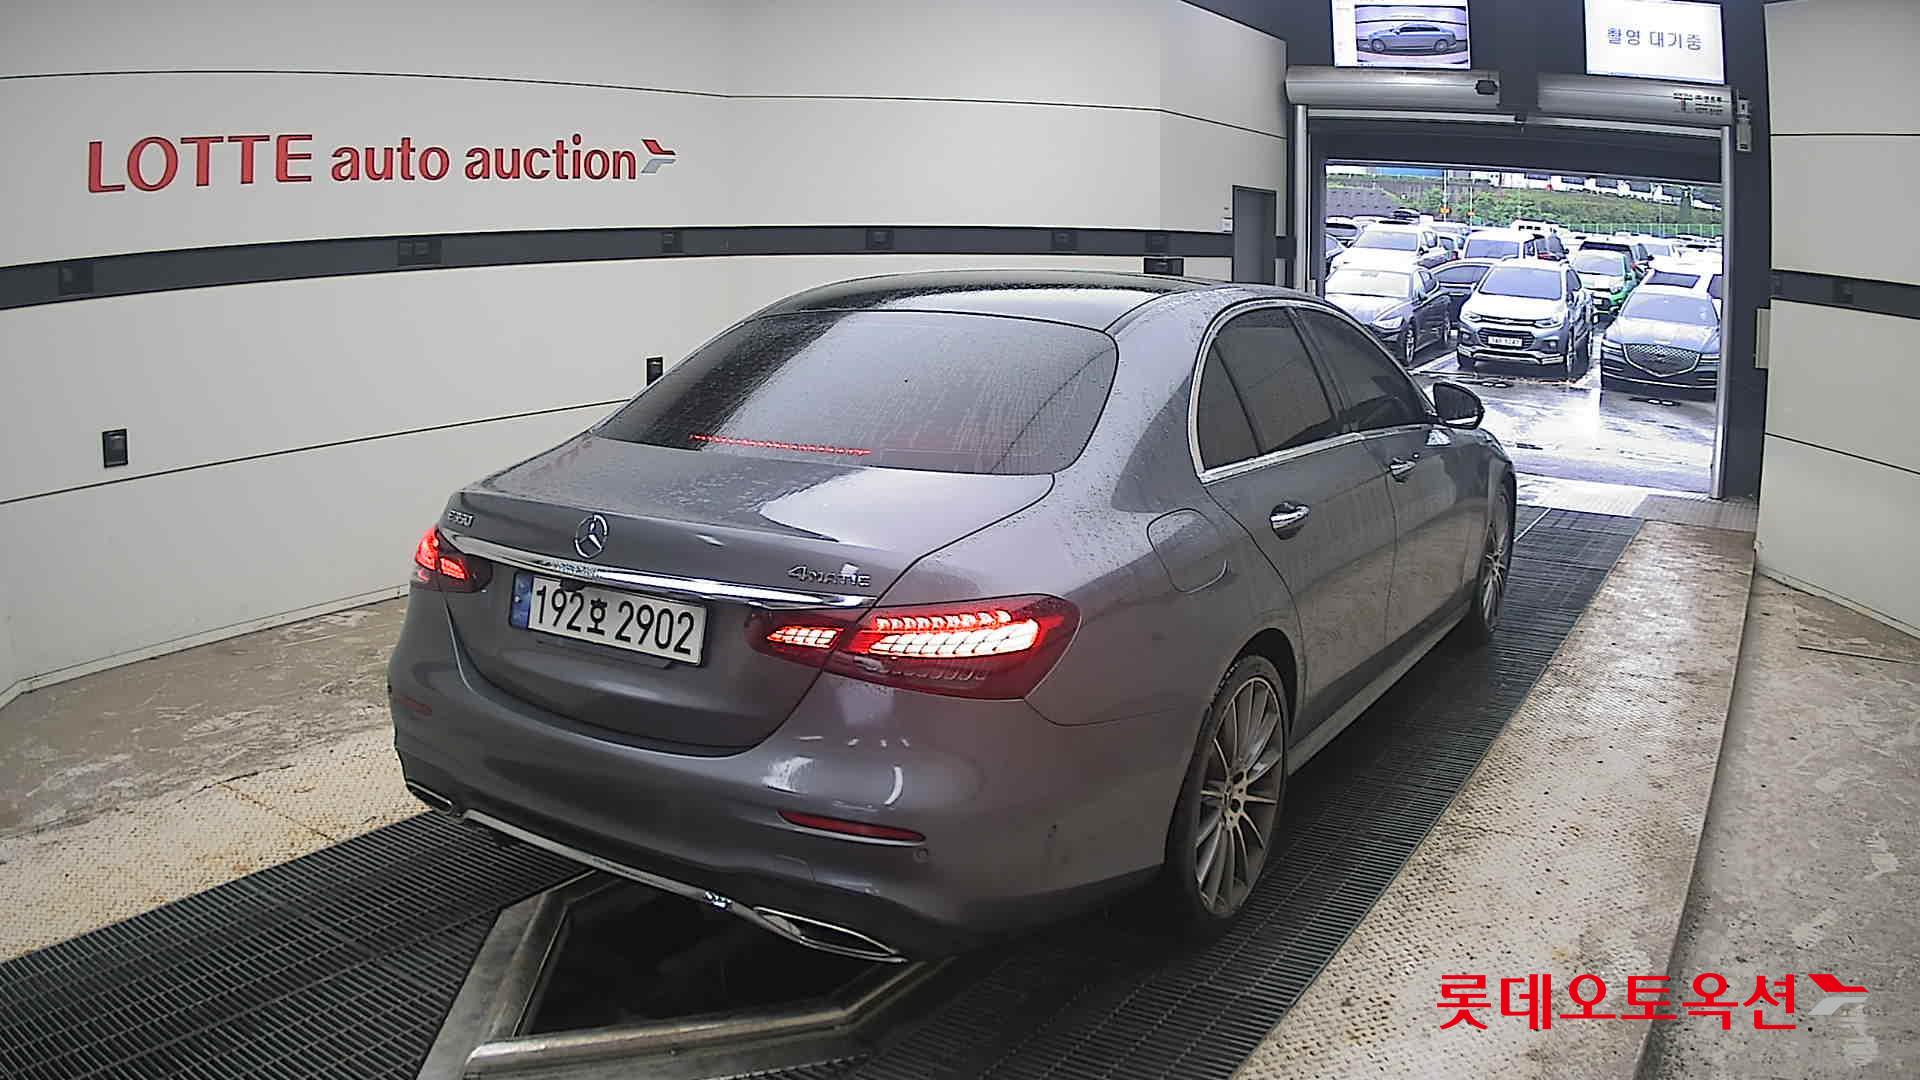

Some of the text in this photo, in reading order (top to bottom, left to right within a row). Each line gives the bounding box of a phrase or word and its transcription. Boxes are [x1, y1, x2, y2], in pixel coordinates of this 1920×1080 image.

[1607, 27, 1703, 51] 촬영 대기중
[88, 133, 637, 193] LOTTE auto auction
[614, 600, 695, 656] 2902
